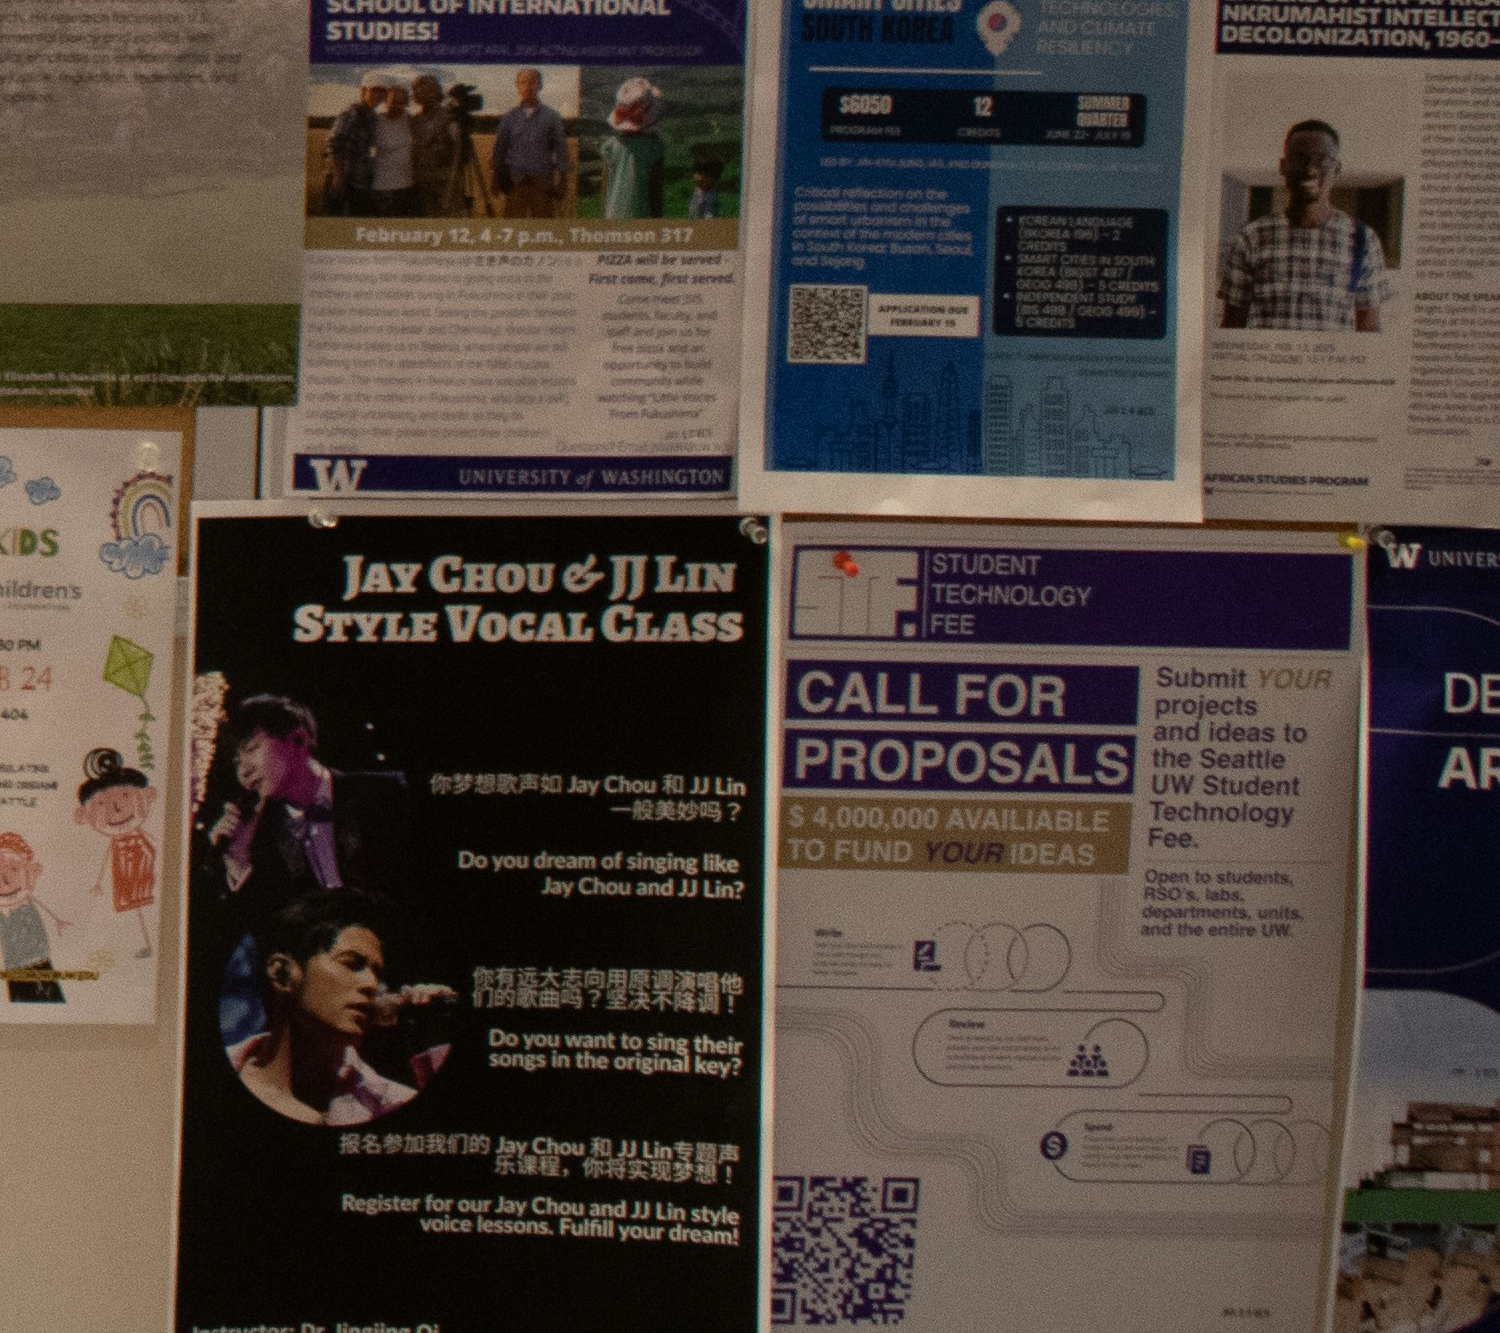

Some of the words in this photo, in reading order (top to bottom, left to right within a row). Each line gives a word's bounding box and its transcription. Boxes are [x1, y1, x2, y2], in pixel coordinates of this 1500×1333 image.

[326, 21, 439, 41] STUDIES!
[459, 468, 572, 486] UNIVERSITY
[576, 468, 594, 488] of
[602, 468, 724, 486] WASHINGTON
[797, 672, 939, 715] CALL
[955, 673, 1065, 717] FOR
[794, 738, 1129, 786] PROPOSALS
